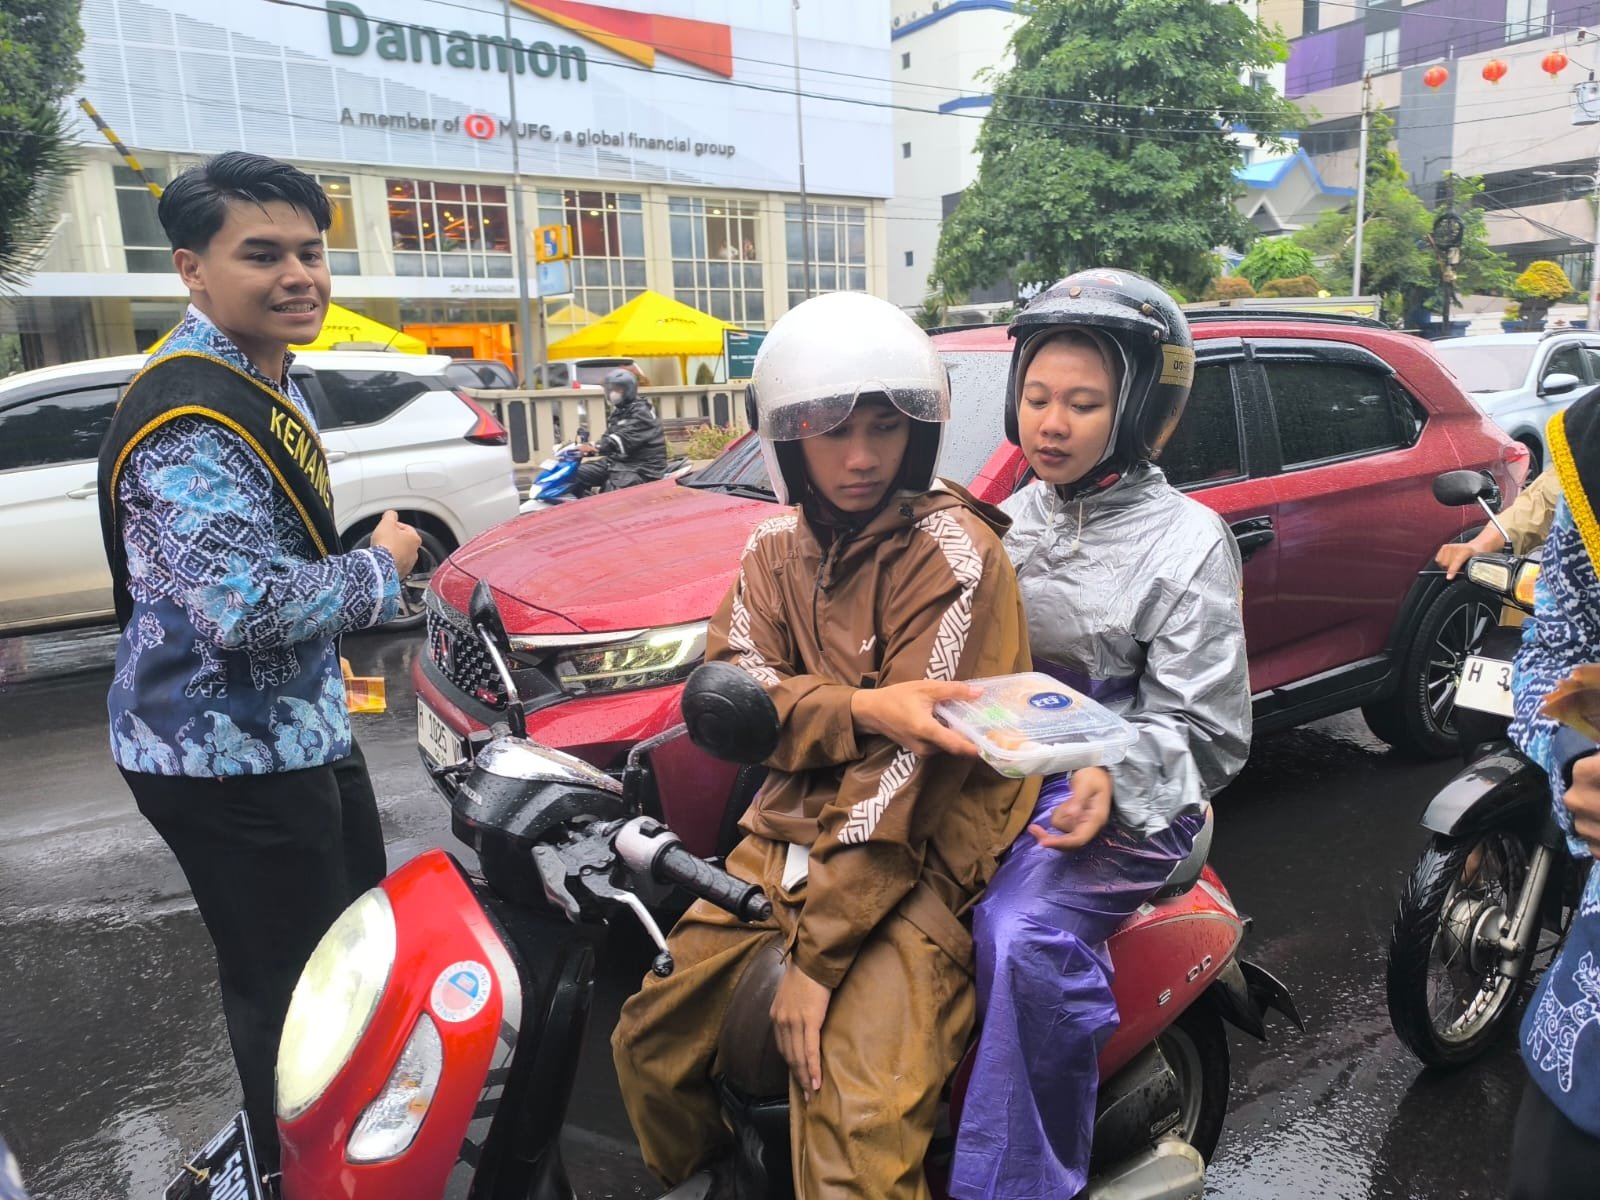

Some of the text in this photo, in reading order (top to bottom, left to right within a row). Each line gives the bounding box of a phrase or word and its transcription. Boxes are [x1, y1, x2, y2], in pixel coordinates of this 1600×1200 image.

[325, 0, 588, 82] Danamon
[340, 108, 354, 126] A
[359, 111, 436, 132] member
[443, 116, 460, 133] of
[563, 130, 572, 143] a
[577, 128, 624, 147] global
[628, 132, 691, 152] financial
[694, 141, 735, 157] group
[1468, 661, 1484, 683] H
[428, 713, 448, 754] 1025
[204, 1120, 238, 1160] H
